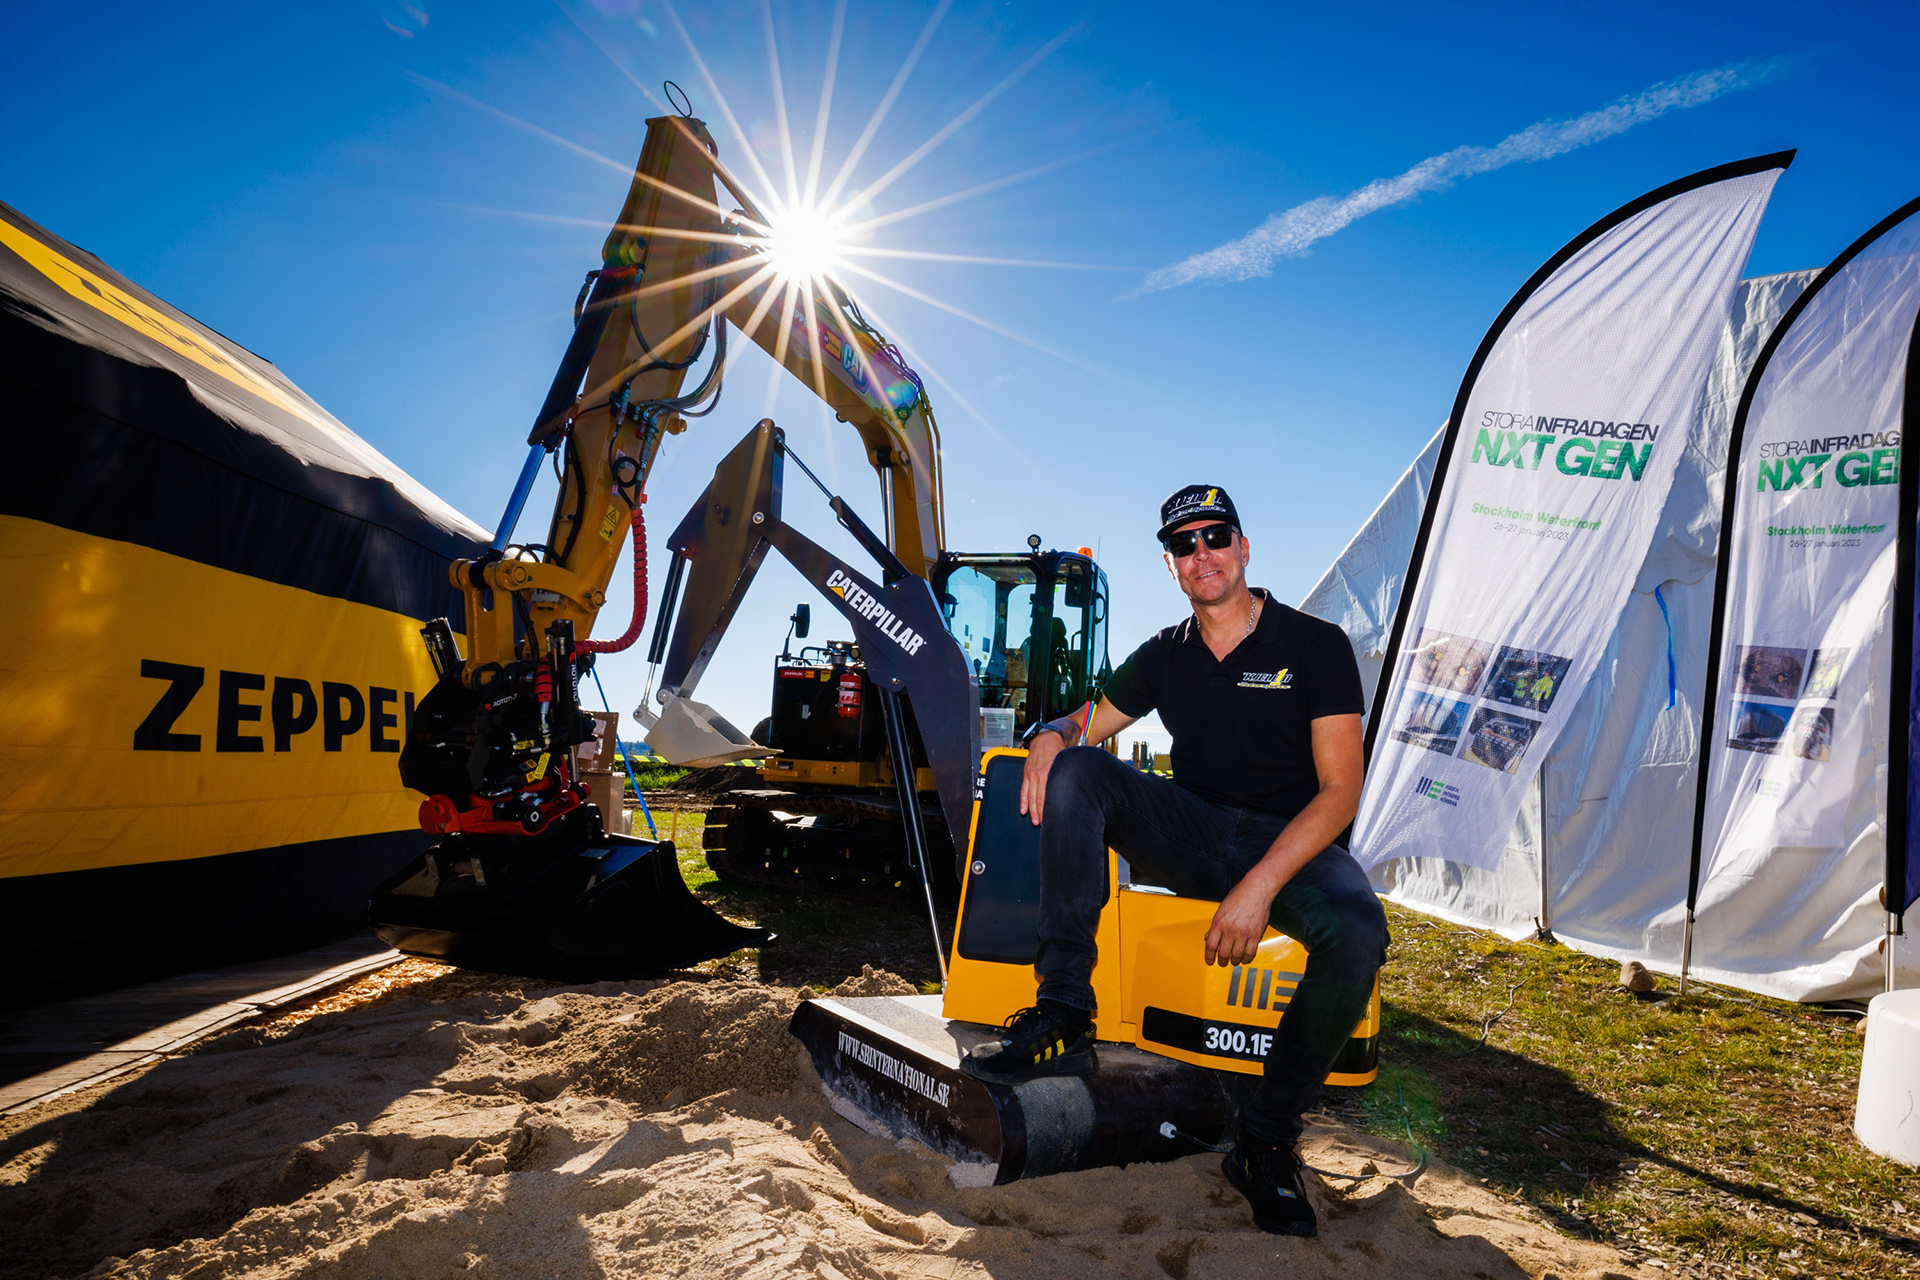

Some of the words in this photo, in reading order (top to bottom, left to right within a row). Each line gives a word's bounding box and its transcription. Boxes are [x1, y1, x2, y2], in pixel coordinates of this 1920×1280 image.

[843, 342, 866, 383] CAT
[1471, 428, 1556, 471] NXT
[1556, 437, 1654, 482] GEN
[1757, 454, 1832, 492] NXT
[1471, 502, 1533, 522] Stockholm
[1537, 511, 1602, 531] Waterfront
[1494, 522, 1518, 534] 26-27
[1518, 526, 1545, 538] januari
[1546, 529, 1569, 541] 2023
[1767, 525, 1826, 537] Stockholm
[1829, 523, 1887, 535] Waterfront
[1790, 540, 1813, 548] 26-27
[1813, 540, 1840, 549] januari
[1841, 539, 1861, 548] 2023
[826, 569, 924, 657] CATERPILLAR
[838, 1031, 950, 1108] WWW.SBINTERNATIONAL.SE
